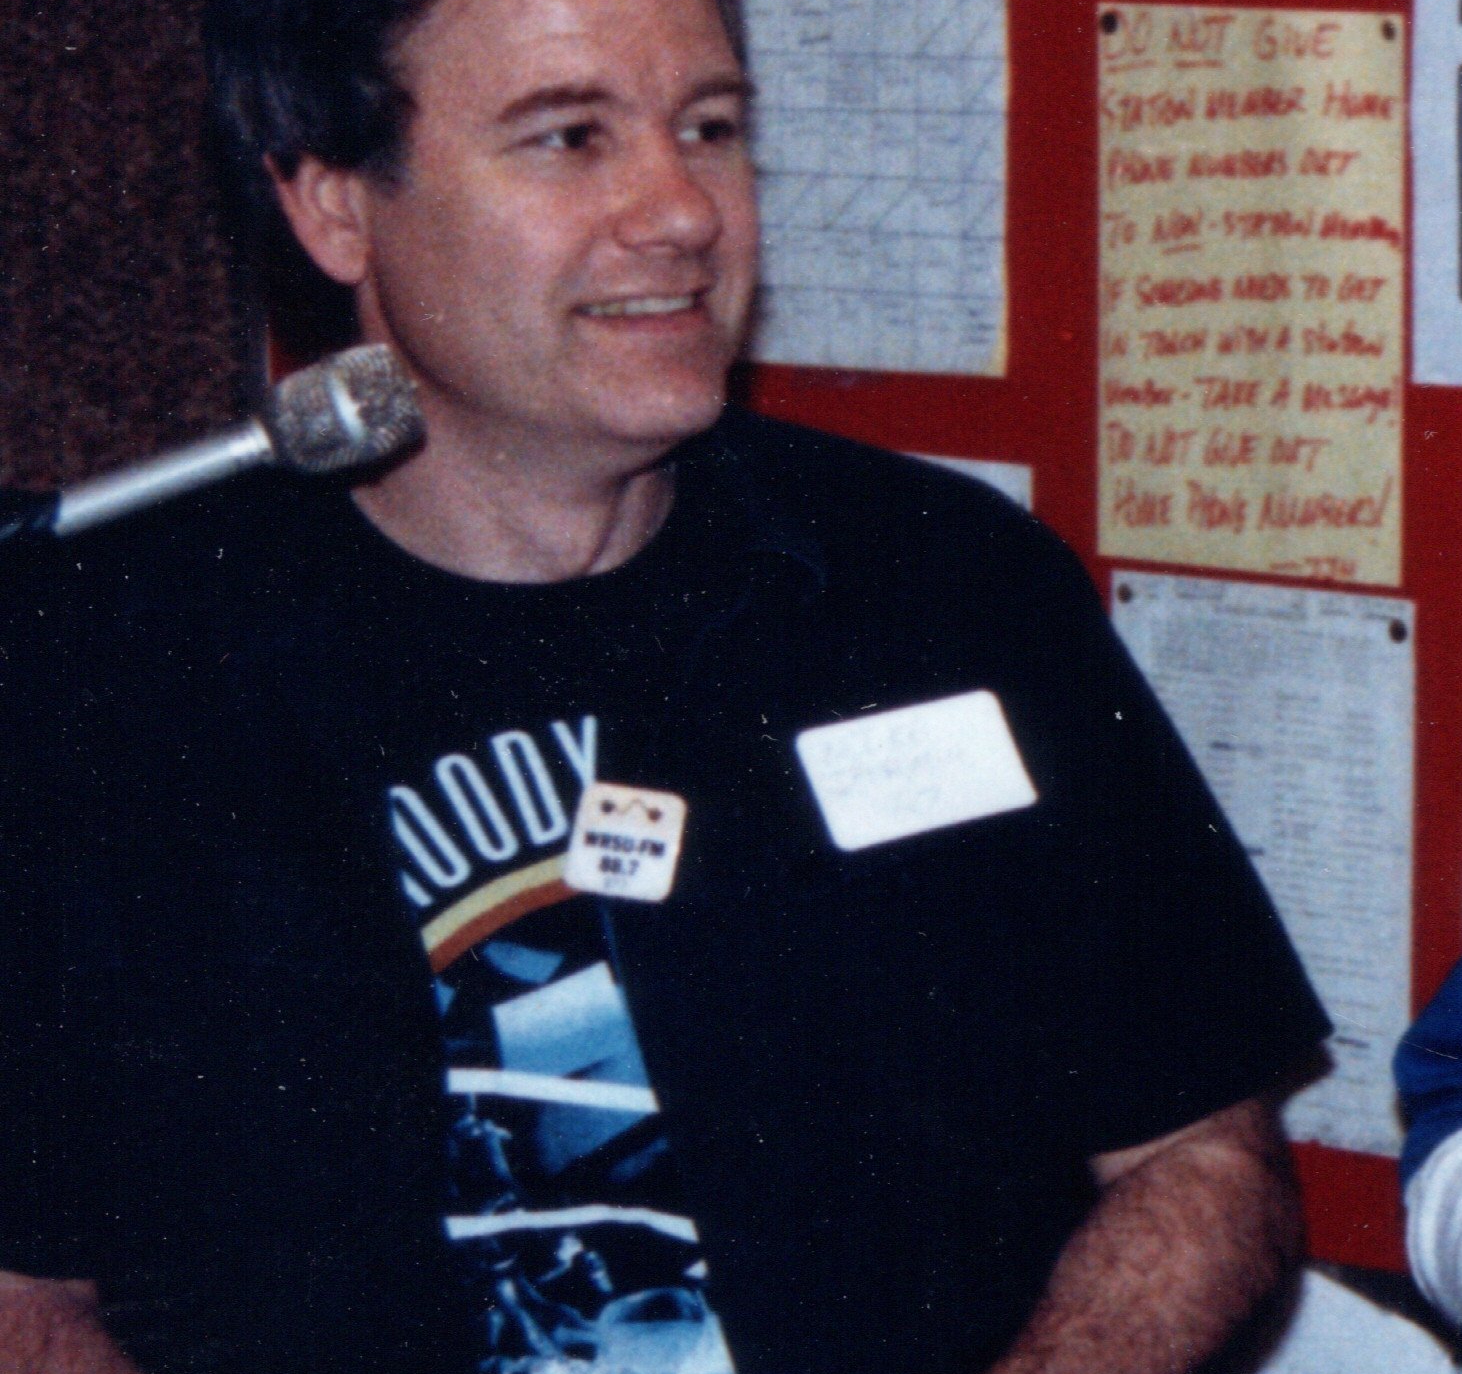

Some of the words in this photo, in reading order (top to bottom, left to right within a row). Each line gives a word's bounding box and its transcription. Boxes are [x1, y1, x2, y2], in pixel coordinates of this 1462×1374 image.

[1166, 14, 1235, 53] NOT
[1253, 16, 1343, 62] GIVE
[388, 713, 598, 907] OODY
[583, 830, 666, 859] WRSU-FM
